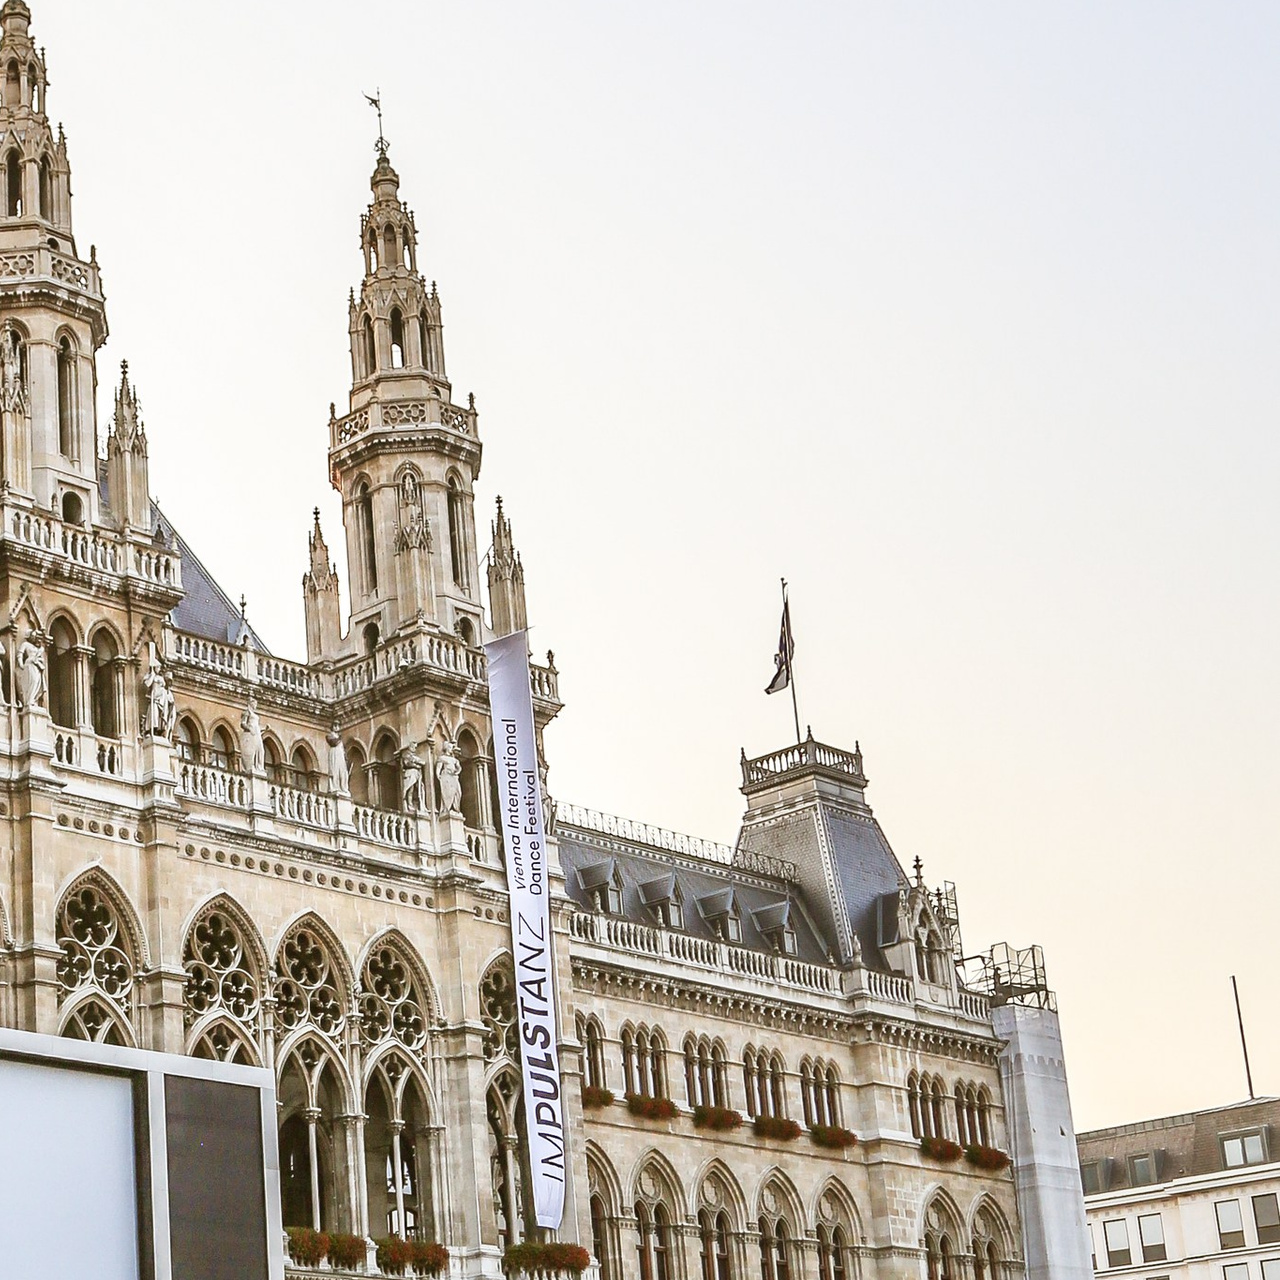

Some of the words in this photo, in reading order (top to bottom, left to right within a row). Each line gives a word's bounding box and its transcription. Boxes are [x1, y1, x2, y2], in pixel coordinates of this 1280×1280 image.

[501, 718, 520, 830] International
[523, 769, 539, 835] Festival
[512, 835, 527, 890] Vienna
[529, 840, 542, 896] Dance
[518, 911, 564, 1183] IMPULSTANZ
